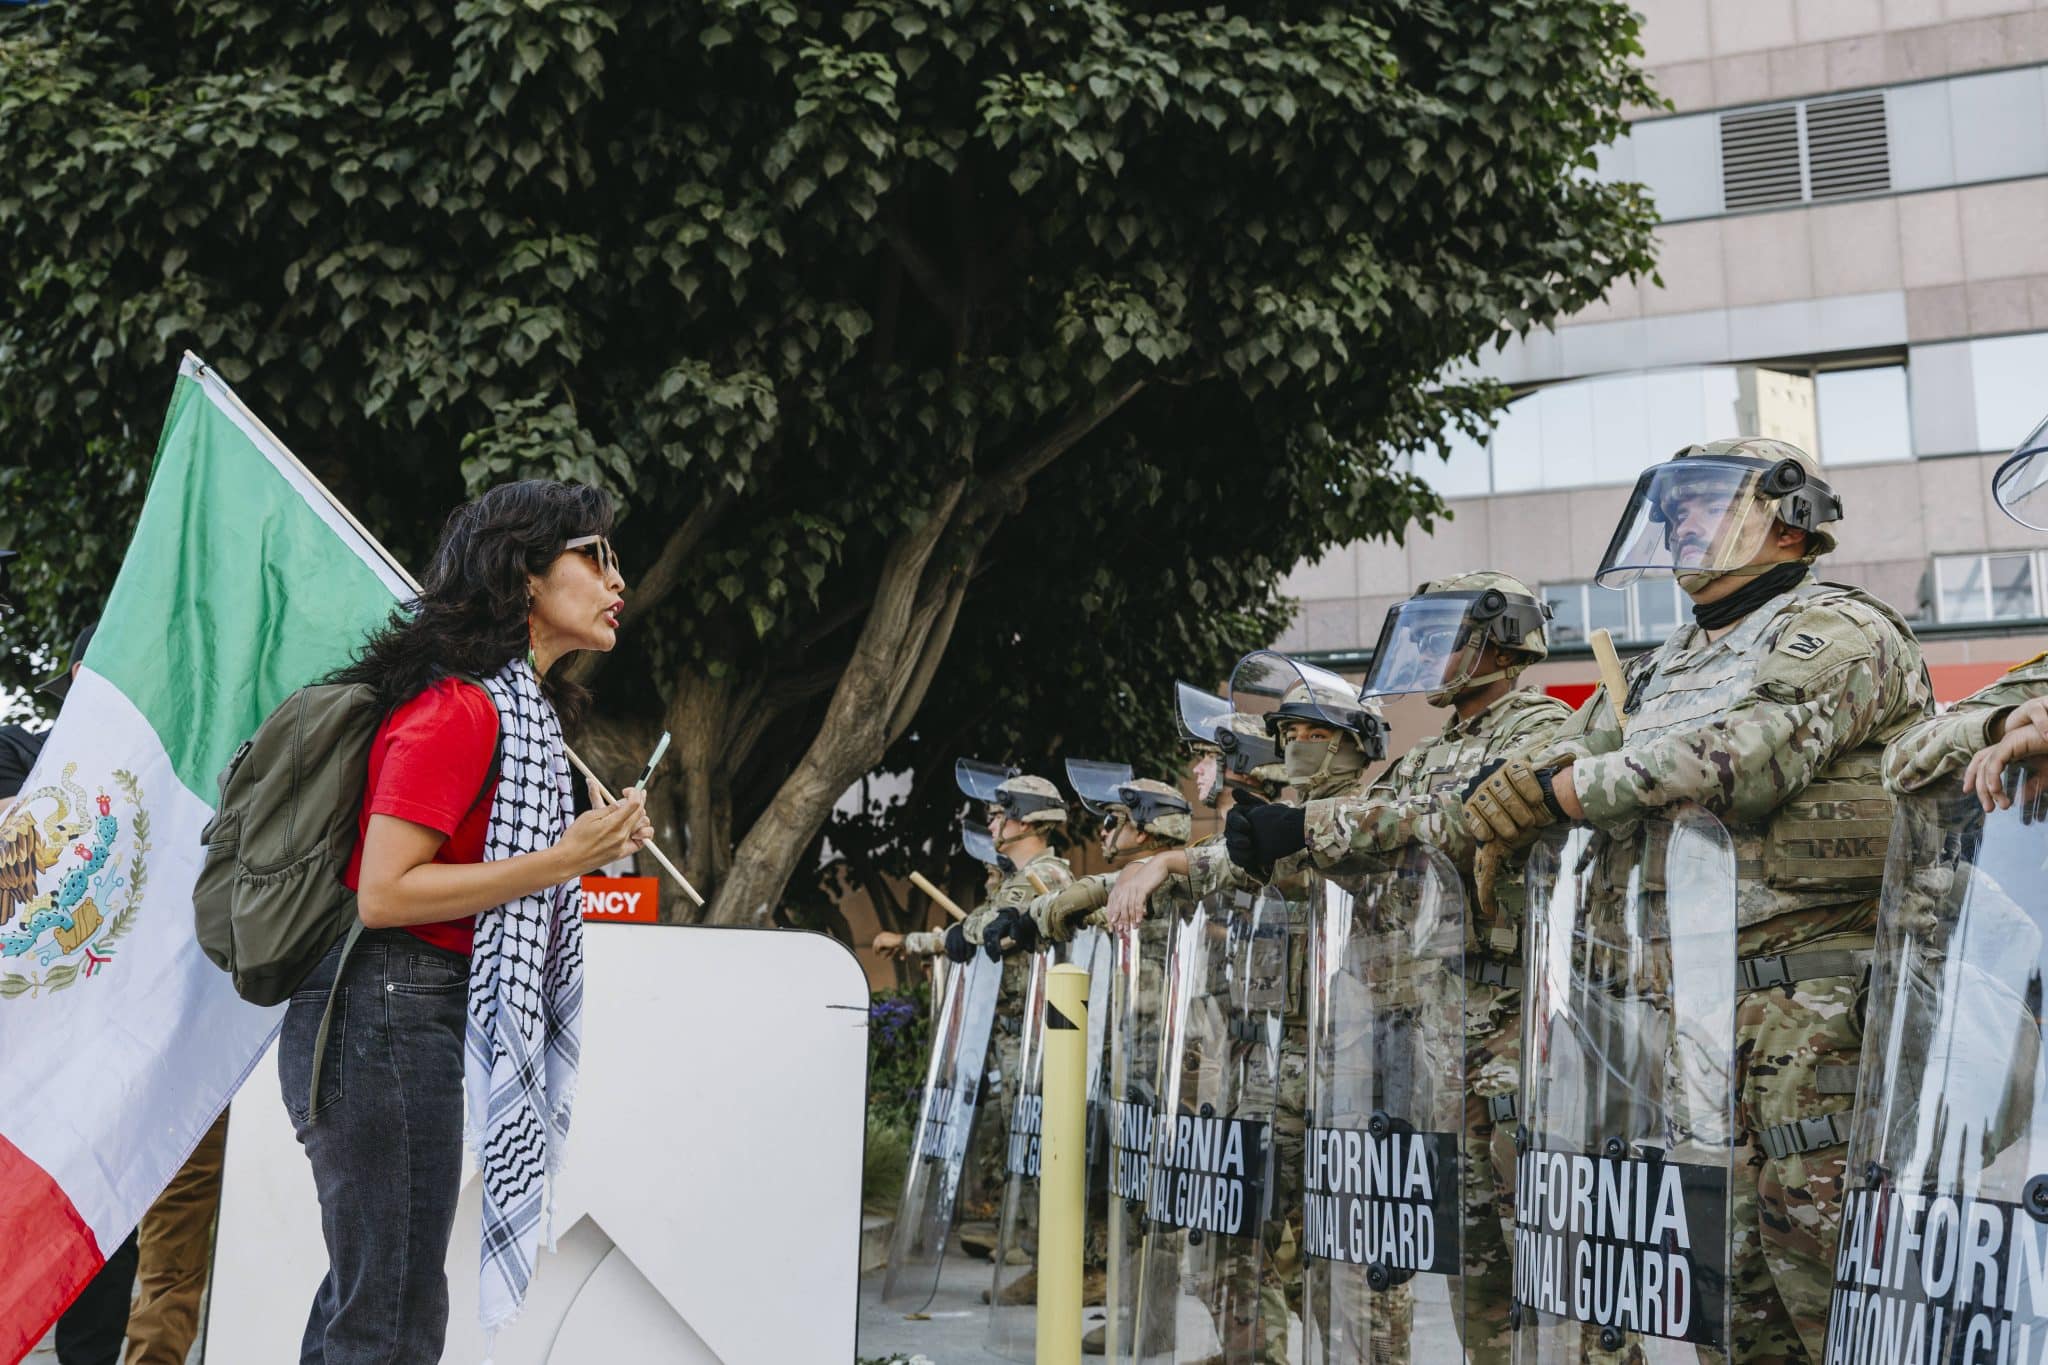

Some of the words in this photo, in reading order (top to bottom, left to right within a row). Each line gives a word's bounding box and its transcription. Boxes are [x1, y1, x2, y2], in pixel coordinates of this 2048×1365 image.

[1175, 1171, 1244, 1235] GUARD
[1350, 1198, 1435, 1271] GUARD
[1574, 1239, 1691, 1338] GUARD
